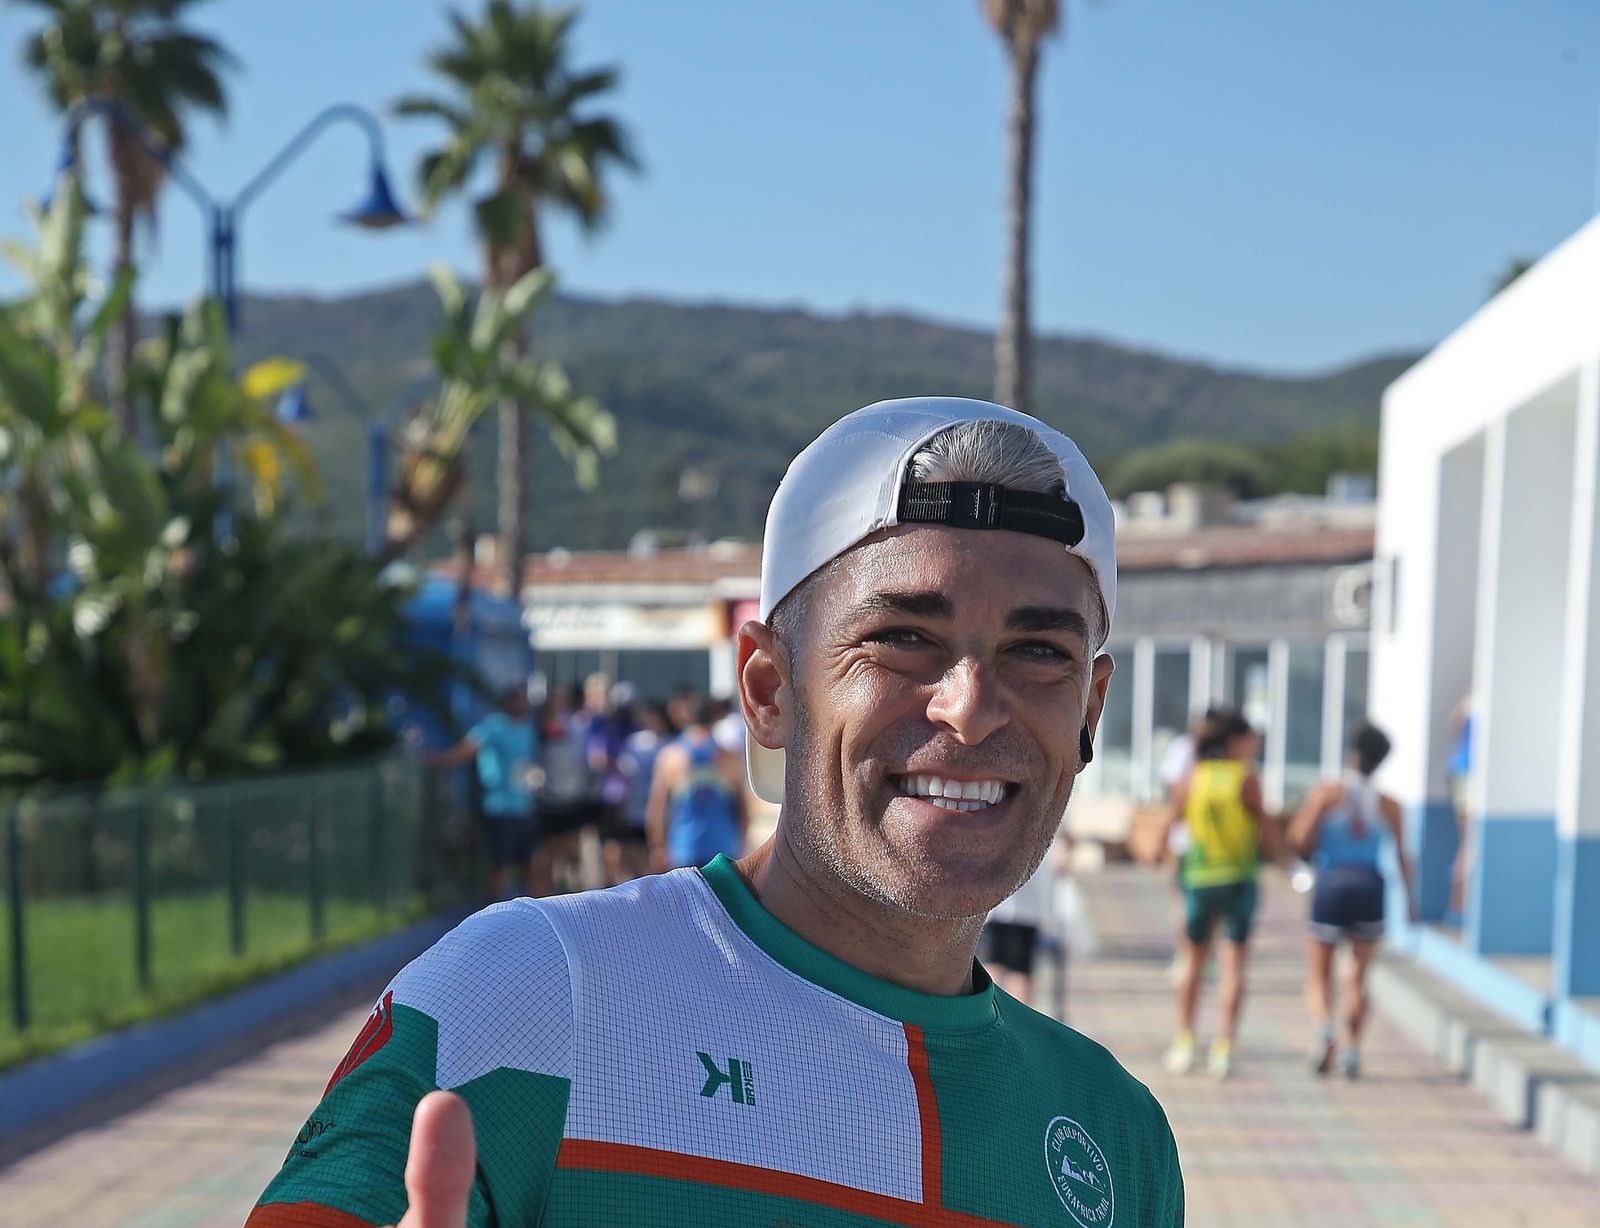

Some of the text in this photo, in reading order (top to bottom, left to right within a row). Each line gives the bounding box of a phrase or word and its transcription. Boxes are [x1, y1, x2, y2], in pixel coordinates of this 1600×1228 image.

[1062, 1125, 1104, 1172] DEPORTIVO
[1057, 1175, 1110, 1222] EURAFRICA TRAIL
